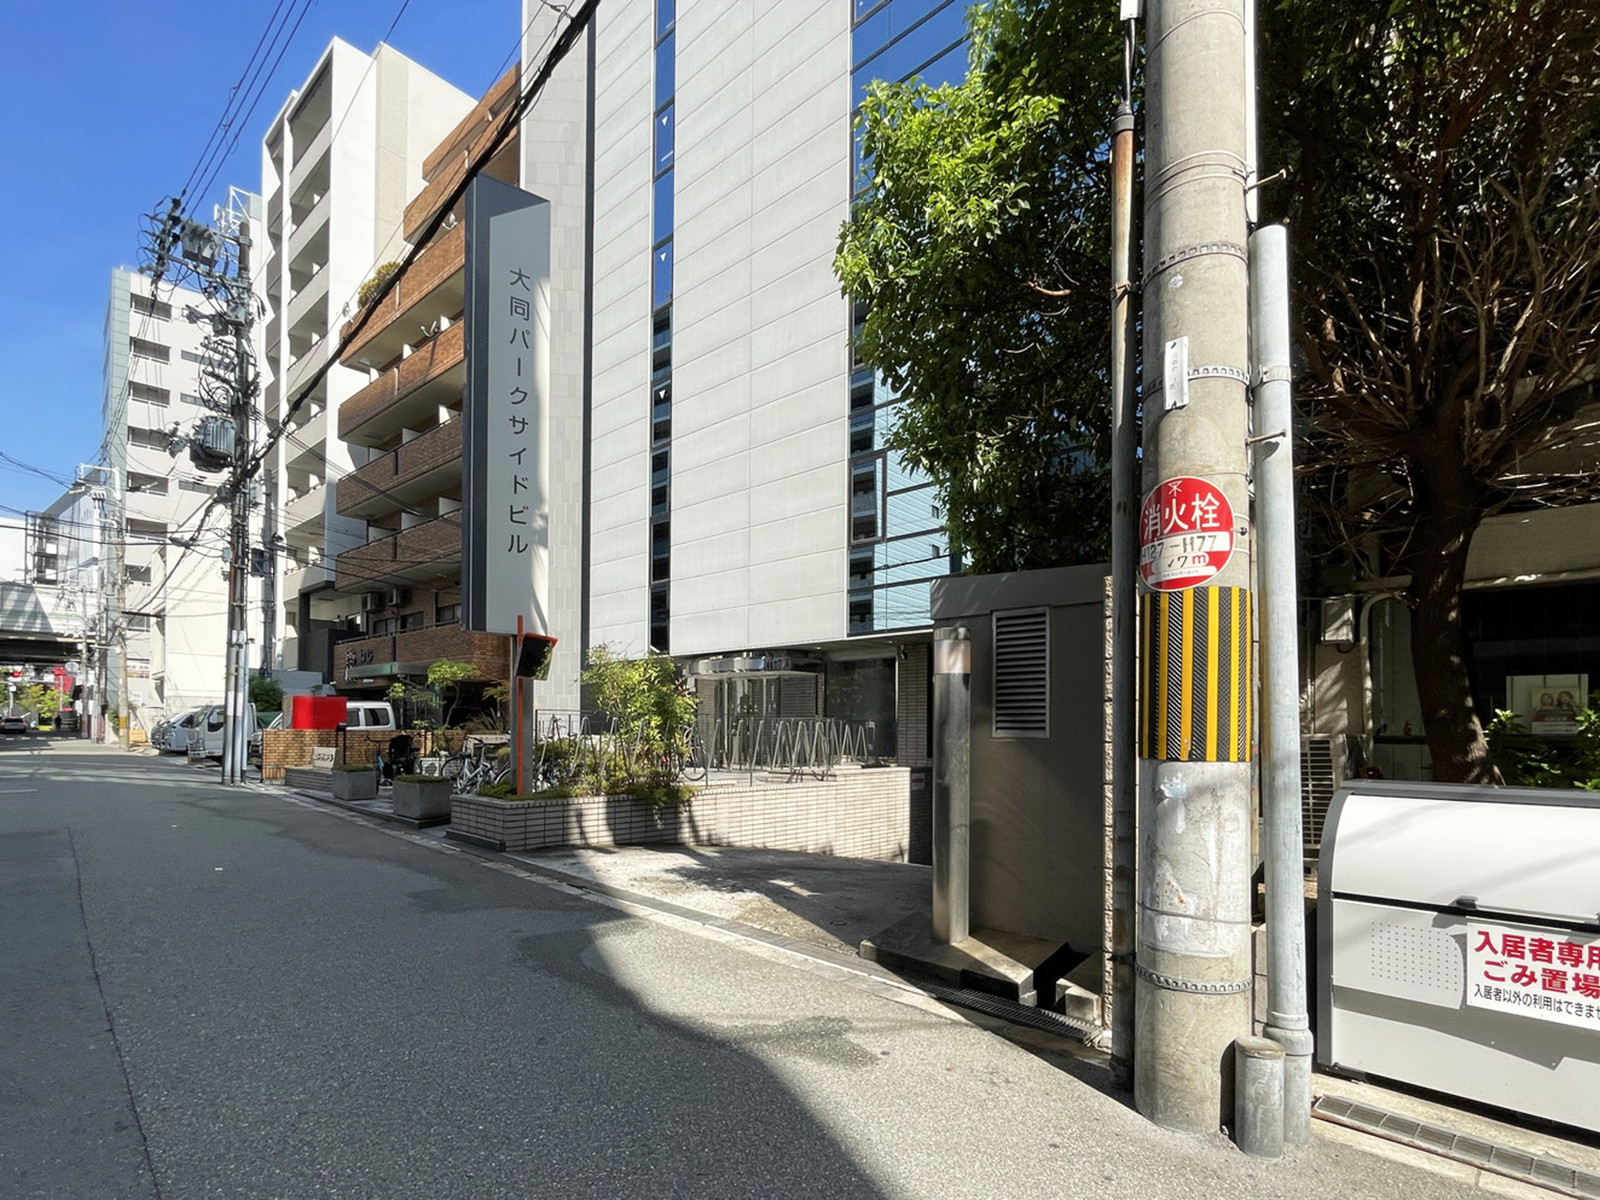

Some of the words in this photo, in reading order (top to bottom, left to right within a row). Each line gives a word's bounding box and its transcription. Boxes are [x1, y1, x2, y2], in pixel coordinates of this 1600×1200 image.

[508, 268, 531, 554] 大同パークサイドビル
[1144, 492, 1220, 541] 消火栓
[1483, 960, 1600, 999] ごみ置場
